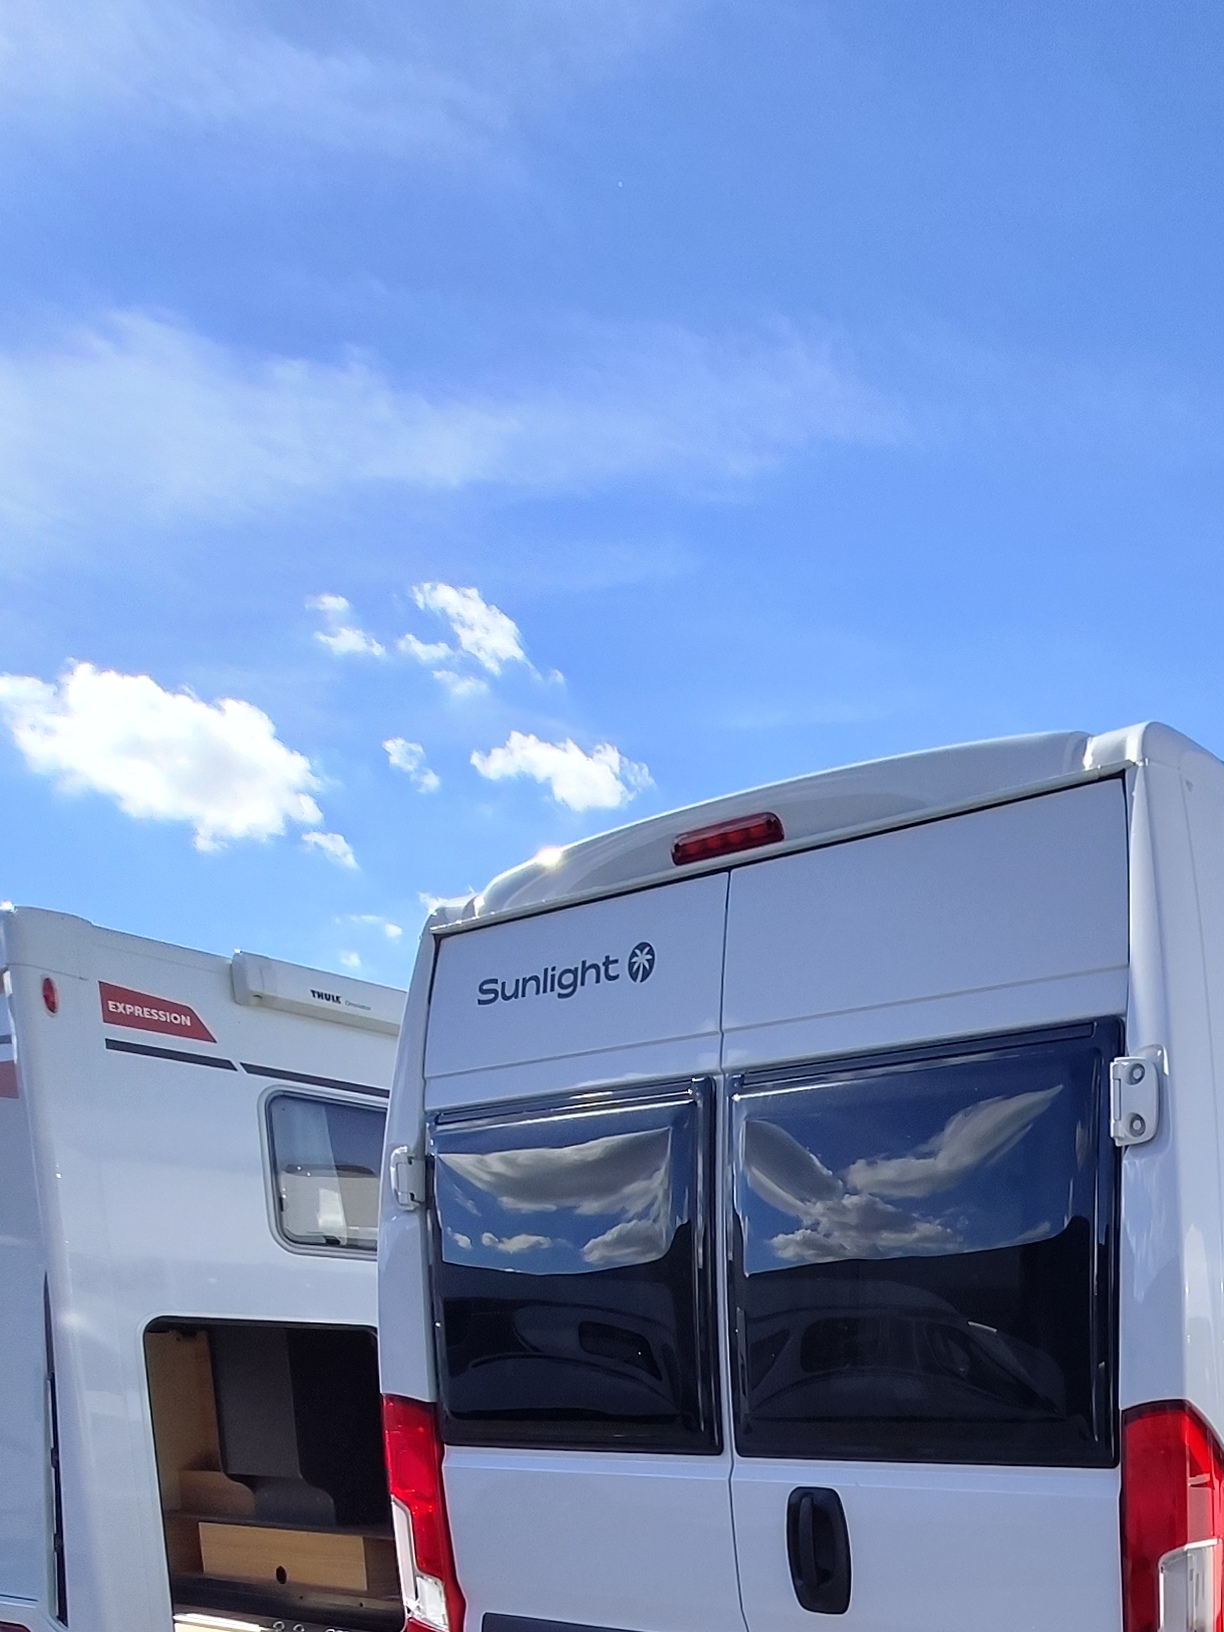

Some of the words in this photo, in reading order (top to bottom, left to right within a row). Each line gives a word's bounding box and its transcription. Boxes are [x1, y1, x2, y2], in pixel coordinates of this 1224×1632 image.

[477, 955, 620, 1005] Sunlight
[310, 989, 342, 1004] THULE
[107, 1000, 191, 1026] EXPRESSION
